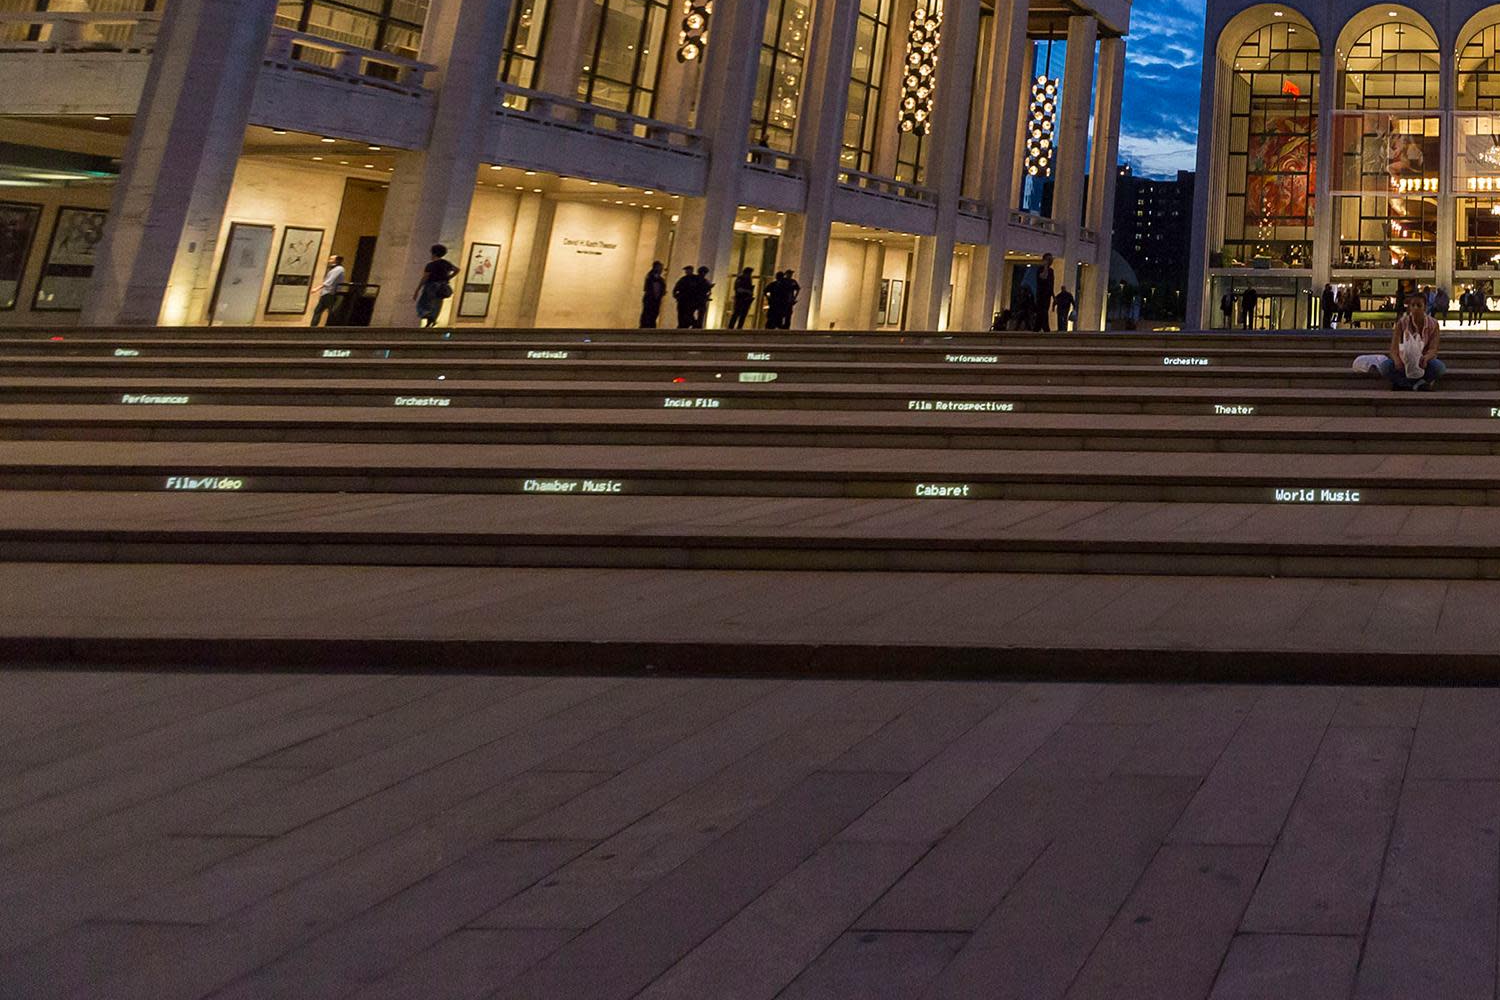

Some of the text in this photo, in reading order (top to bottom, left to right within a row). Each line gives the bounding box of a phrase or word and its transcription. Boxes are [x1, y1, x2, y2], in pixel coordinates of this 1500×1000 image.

[1164, 357, 1208, 365] Orchestras
[394, 397, 450, 406] Orchestras
[664, 398, 720, 408] Indie Film
[908, 401, 1014, 411] Film Retrospectives
[1214, 404, 1255, 414] Theater
[165, 476, 243, 490] Film/Video
[523, 479, 622, 492] Chamber Music
[915, 484, 970, 496] Cabaret
[1275, 489, 1360, 502] World Music
